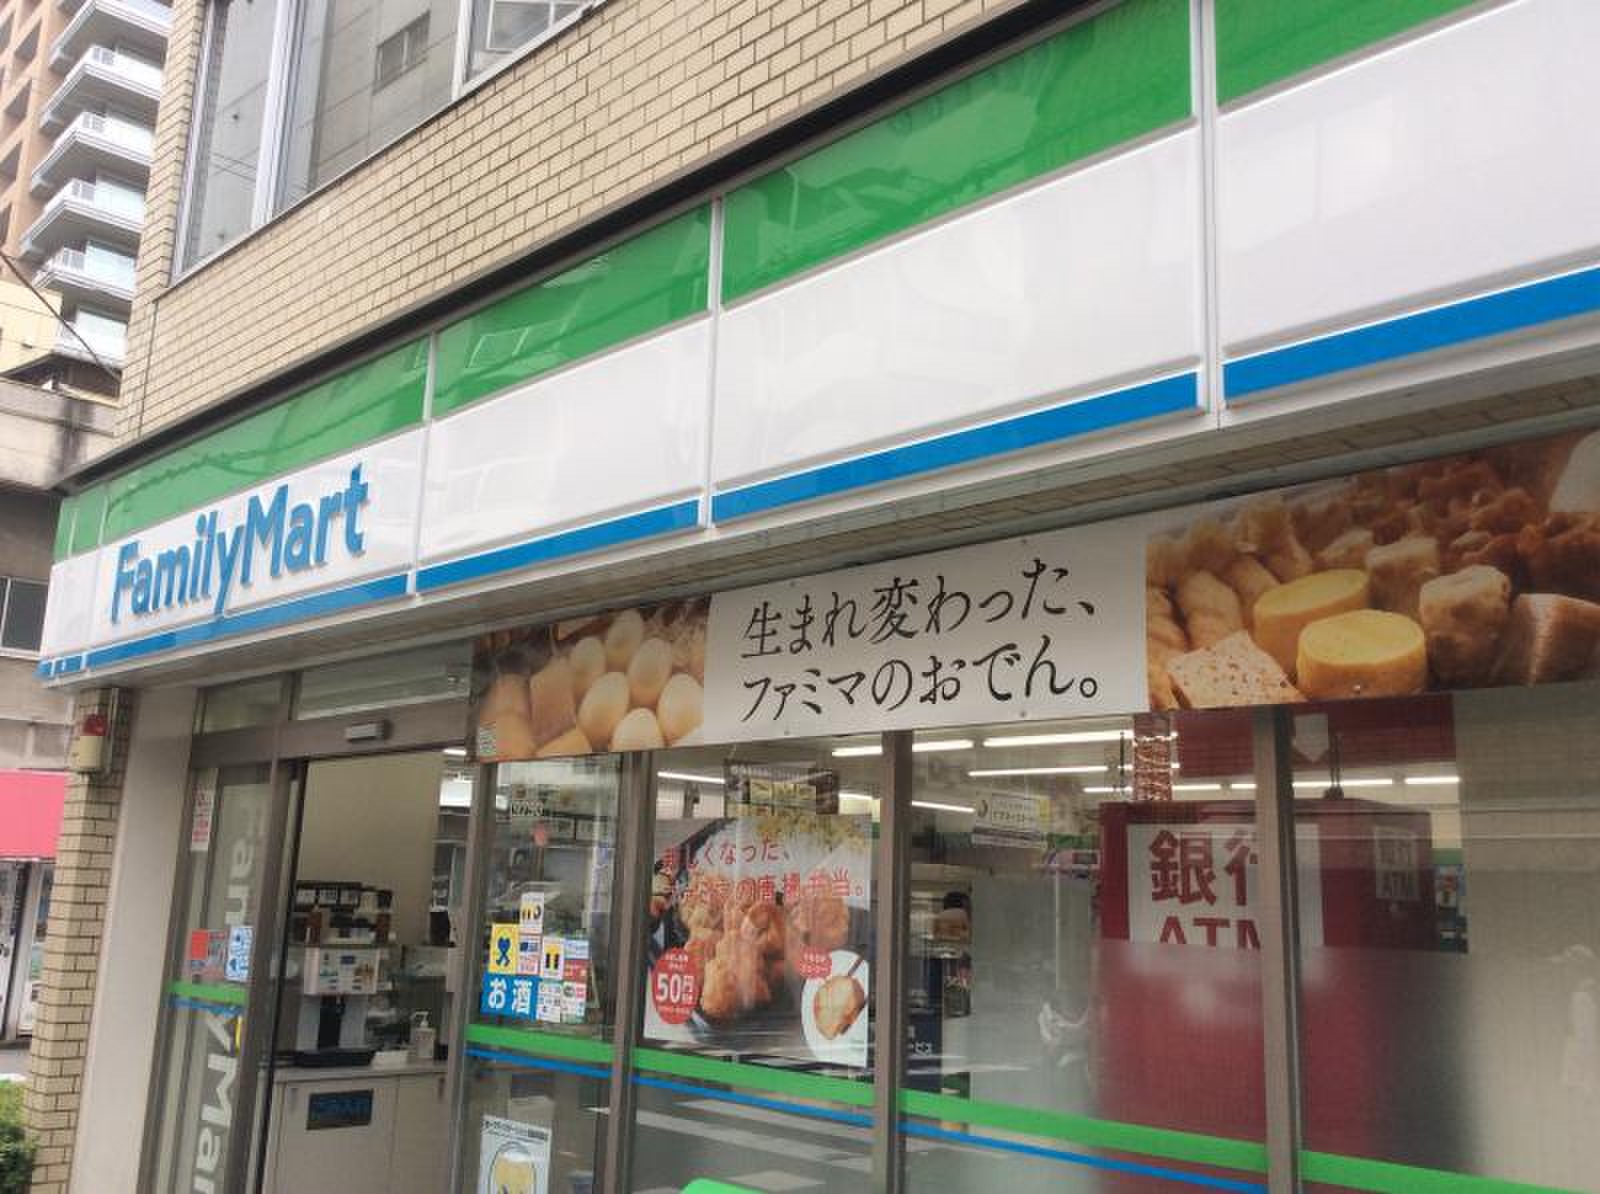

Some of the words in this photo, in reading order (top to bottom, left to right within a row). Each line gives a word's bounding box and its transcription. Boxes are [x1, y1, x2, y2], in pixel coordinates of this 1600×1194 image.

[111, 462, 369, 624] FamilyMart
[741, 558, 1096, 659] 生まれ変わった、
[740, 634, 1099, 722] ファミマのおでん。
[487, 977, 532, 1015] お酒
